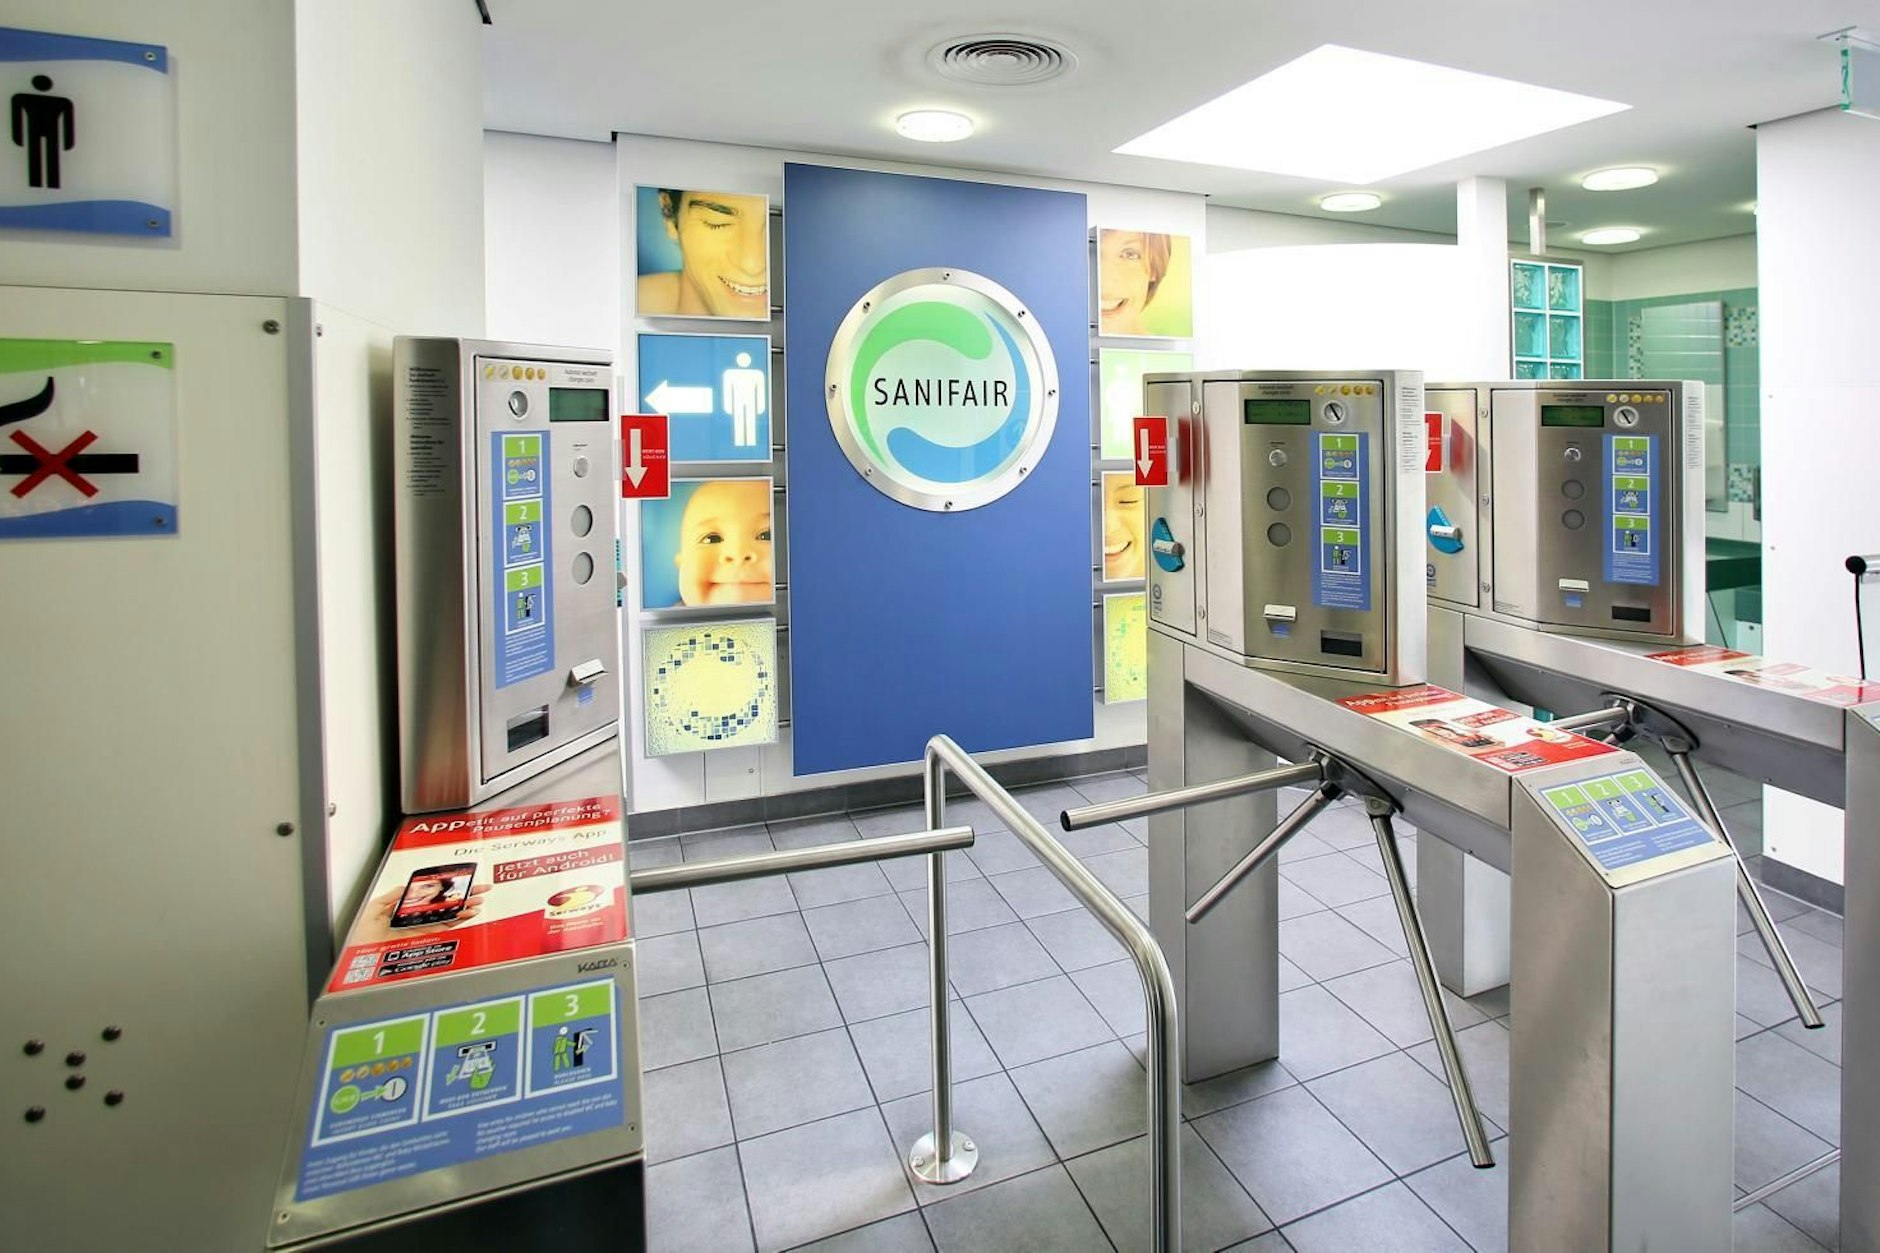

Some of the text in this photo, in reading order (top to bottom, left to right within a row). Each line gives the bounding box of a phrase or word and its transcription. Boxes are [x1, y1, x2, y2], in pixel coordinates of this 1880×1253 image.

[874, 377, 1008, 407] SANIFAIR
[519, 440, 526, 453] 1
[1336, 438, 1342, 448] 1
[1336, 485, 1343, 495] 2
[1628, 479, 1634, 488] 2
[520, 506, 527, 520] 2
[1628, 519, 1634, 528] 3
[1336, 532, 1343, 542] 3
[521, 572, 528, 586] 3
[1629, 776, 1642, 788] 3
[1597, 784, 1609, 795] 2
[1561, 792, 1572, 804] 1
[501, 812, 528, 822] auf
[533, 804, 601, 820] perfekte
[473, 809, 612, 834] Pausenplanung?
[454, 829, 608, 856] Die Serways App
[497, 851, 588, 875] Jetzt auch
[498, 853, 614, 881] für Android!
[564, 994, 579, 1017] 3
[471, 1012, 486, 1035] 2
[373, 1031, 385, 1055] 1
